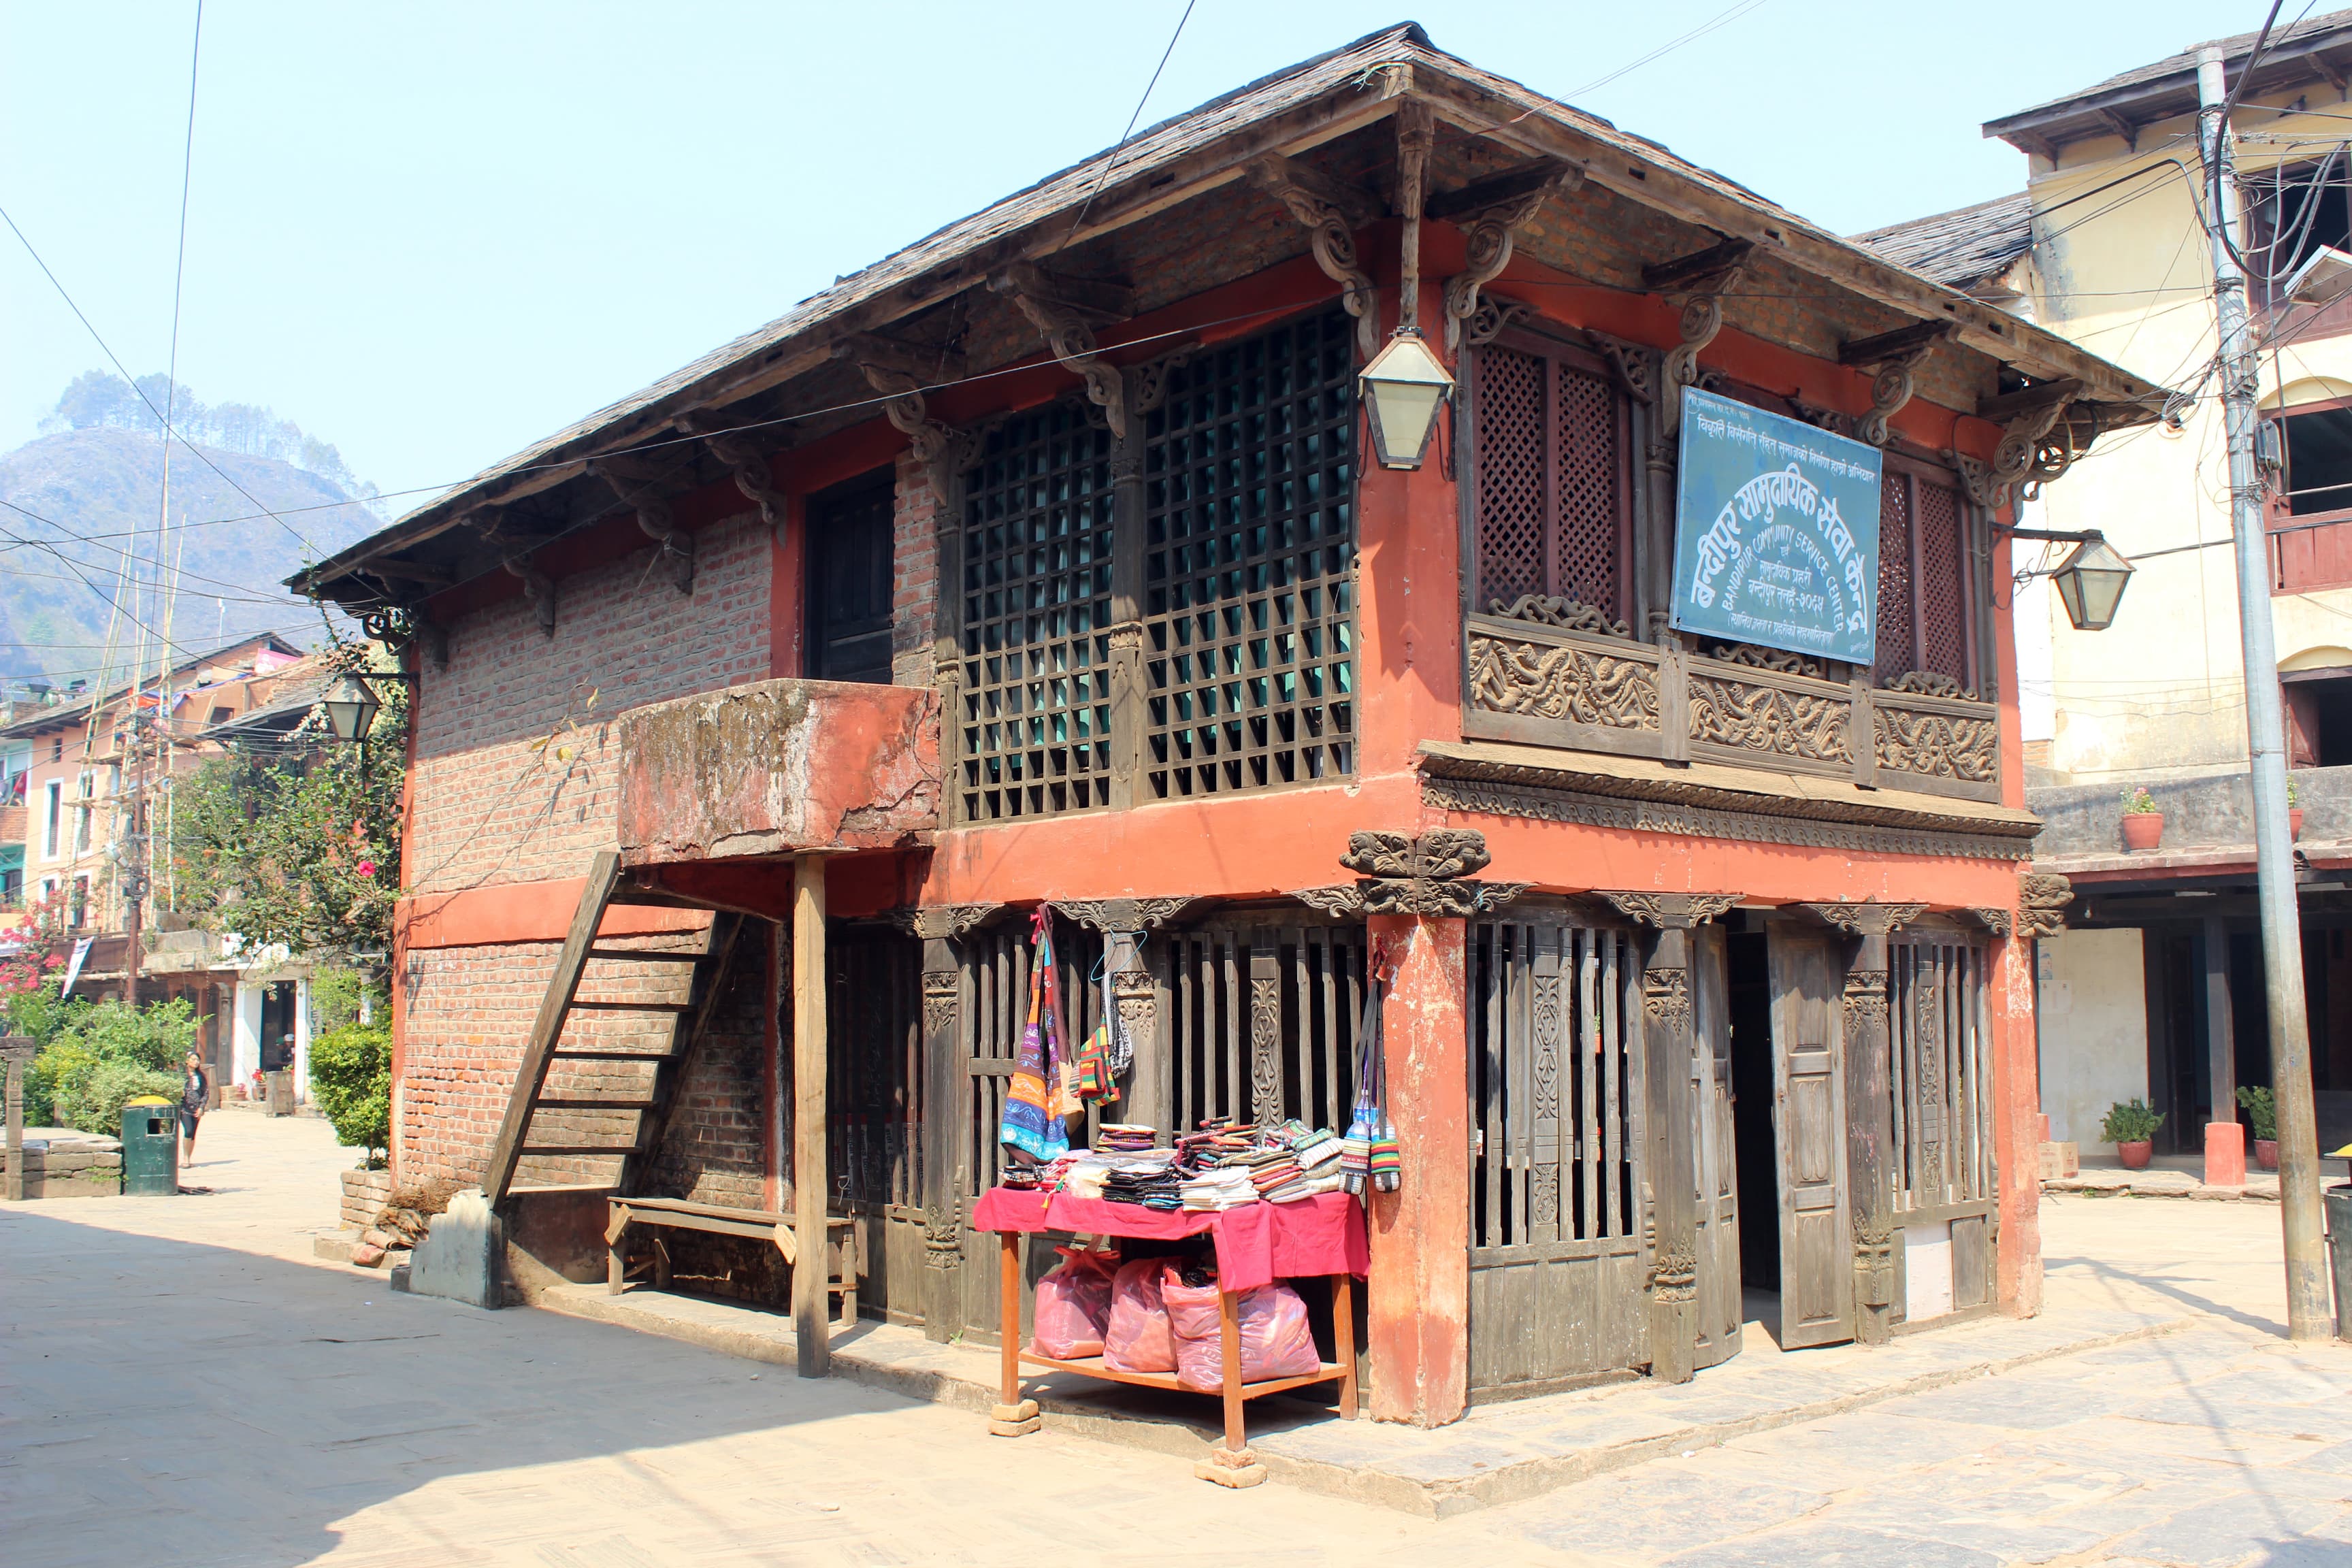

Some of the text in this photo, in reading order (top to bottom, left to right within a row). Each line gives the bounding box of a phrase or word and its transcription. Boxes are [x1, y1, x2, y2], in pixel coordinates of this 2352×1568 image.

[1690, 500, 1742, 608] बन्दीपुर
[1733, 462, 1818, 524] सामुदायिक
[1816, 495, 1856, 564] सेवा
[1722, 524, 1844, 633] BANDIPUR COMMUNITY SERVICE CENTER
